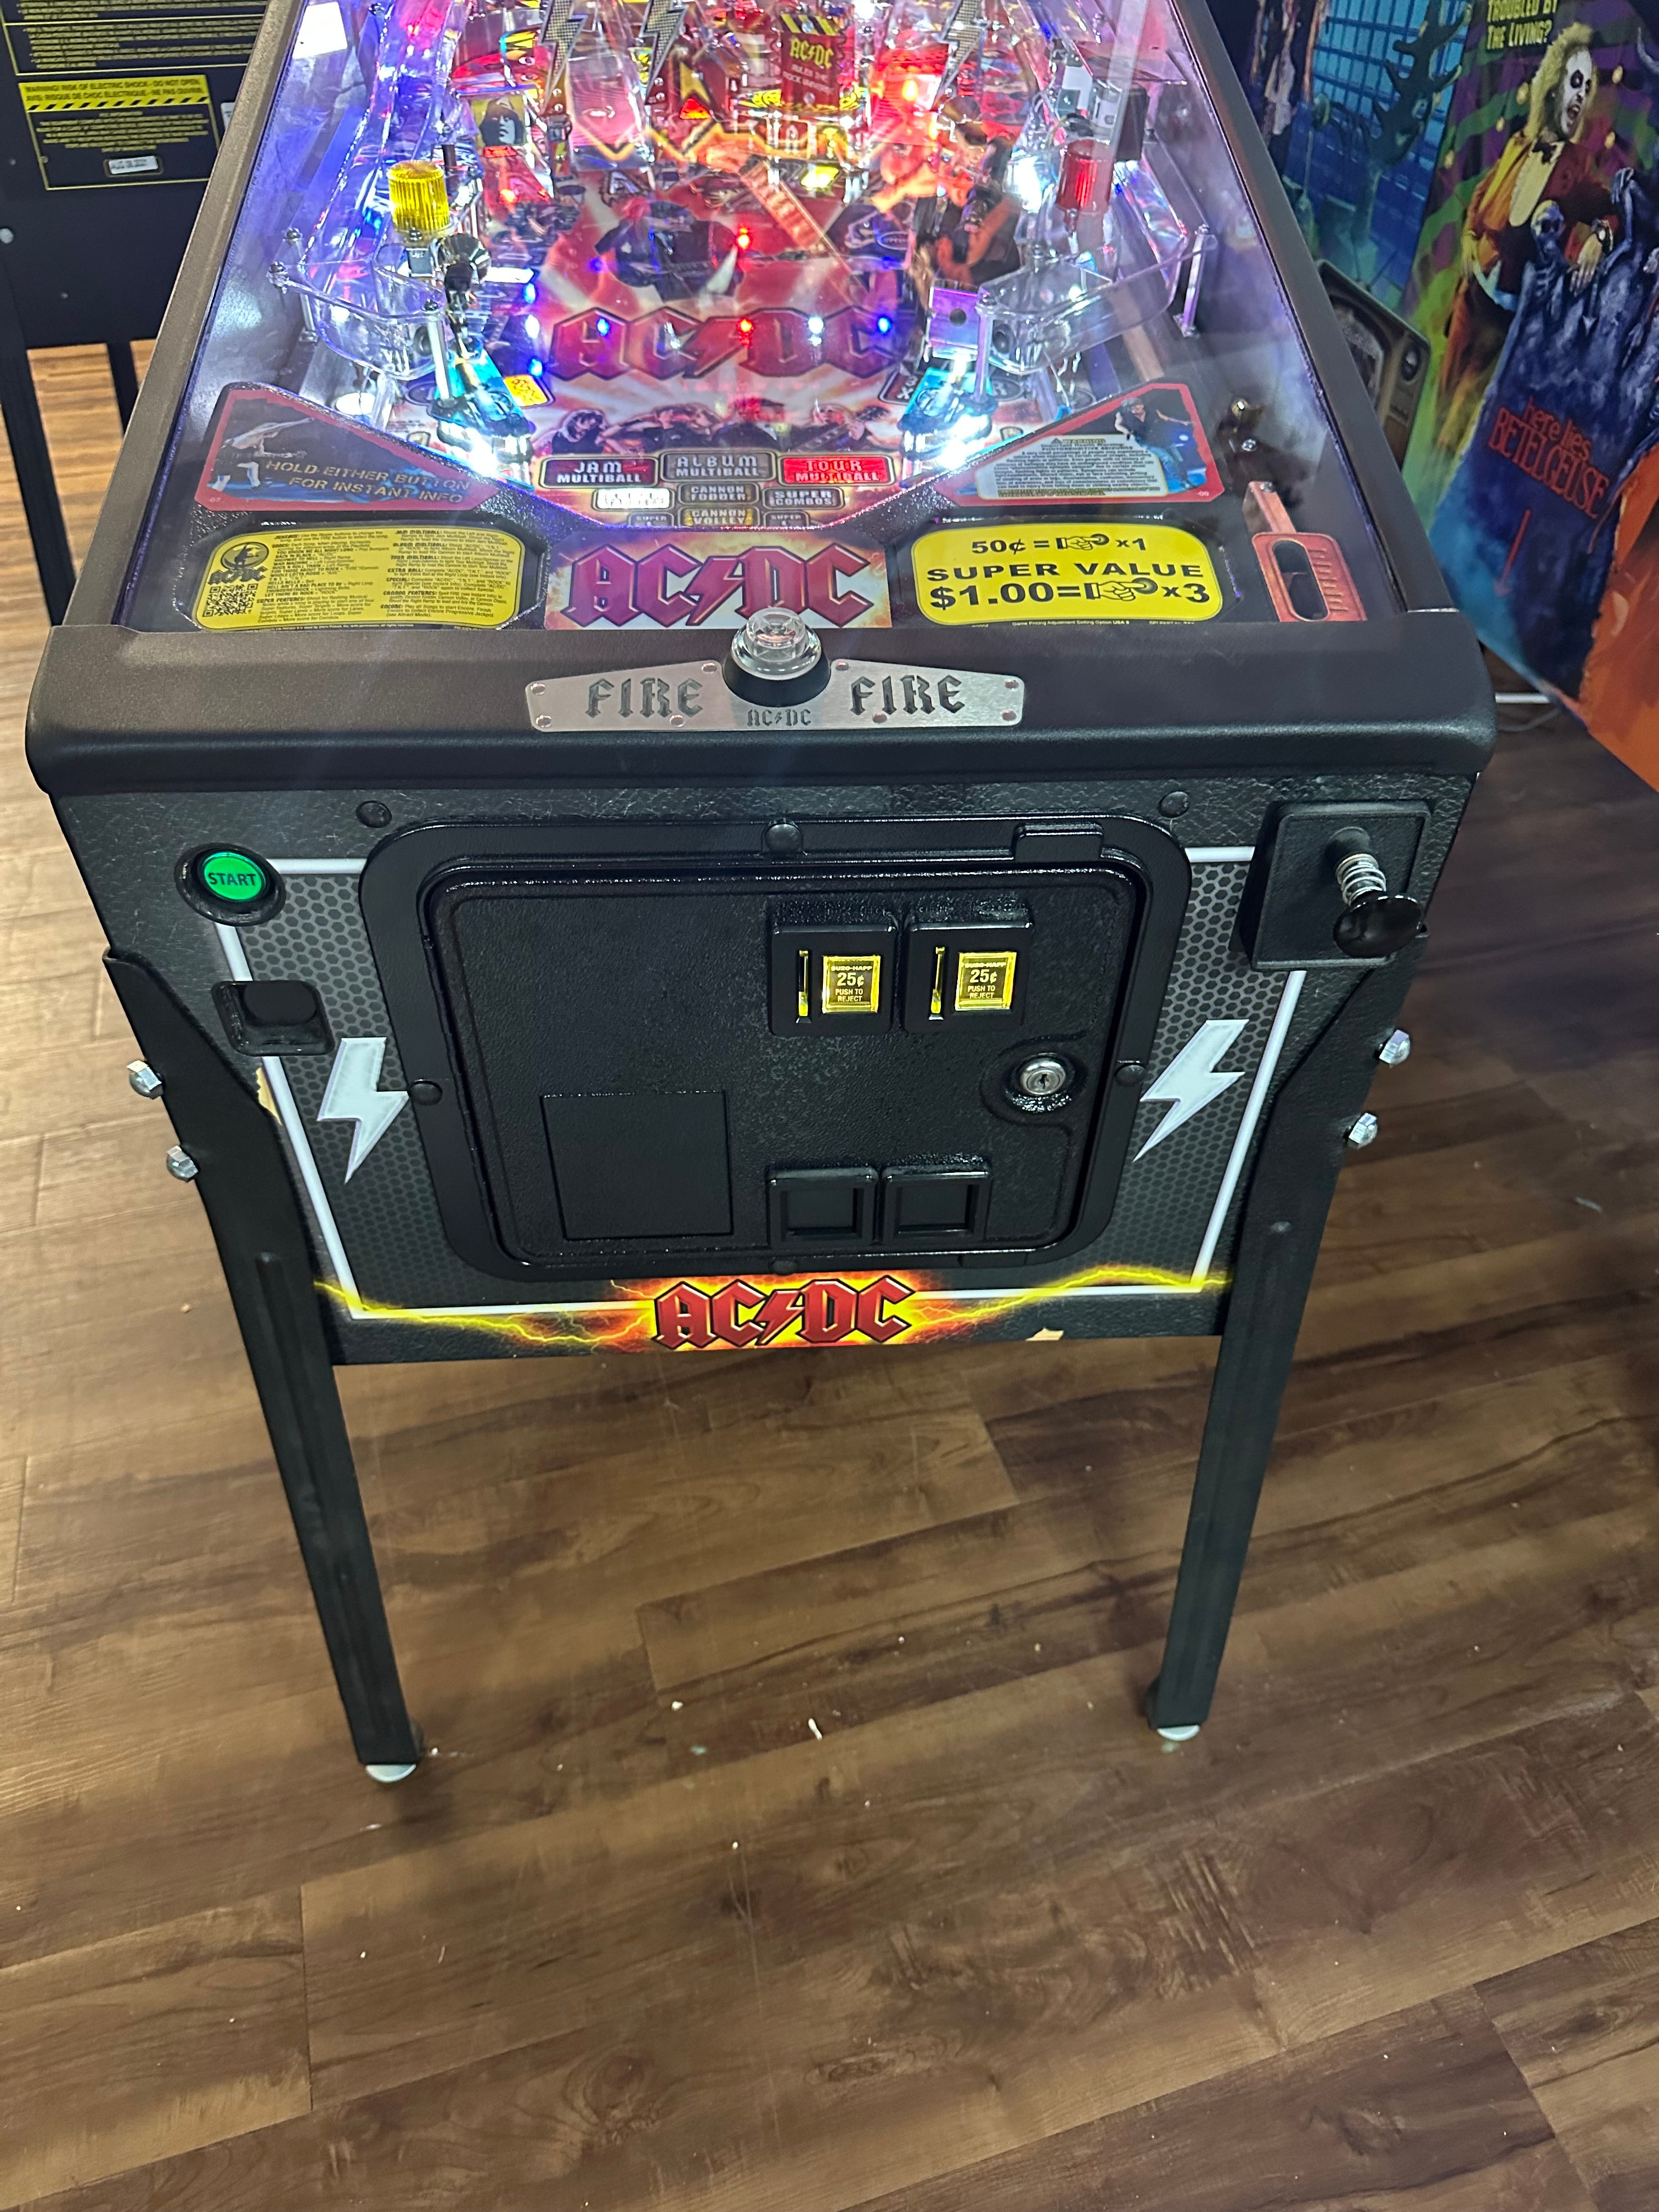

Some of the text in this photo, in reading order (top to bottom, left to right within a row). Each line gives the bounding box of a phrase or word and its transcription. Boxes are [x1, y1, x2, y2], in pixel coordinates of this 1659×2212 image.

[1487, 25, 1506, 49] THE
[789, 37, 834, 69] AC/DC
[1522, 396, 1593, 461] here lies
[574, 461, 622, 473] JAM
[676, 455, 758, 467] ALBUM
[805, 460, 863, 472] TOUR
[1488, 407, 1611, 520] BETELGEUSE
[266, 460, 472, 491] HOLD EITHER BUTTON
[556, 473, 641, 483] MULTIBALL
[676, 467, 759, 477] MULTIBALL
[795, 472, 879, 482] MULTIBALL
[288, 477, 464, 504] FOR INSTANT INFO
[691, 483, 744, 493] CANNON
[774, 490, 832, 499] SUPER
[691, 493, 746, 501] FODDER
[775, 498, 833, 506] COMBOS
[692, 508, 746, 517] CANNON
[693, 516, 747, 525] VOLLEY
[971, 539, 1026, 555] 50¢
[1116, 538, 1147, 551] x1
[927, 563, 1204, 582] SUPER VALUE
[560, 543, 874, 628] AC/DC
[1163, 583, 1210, 603] x3
[585, 674, 966, 718] FIRE FIRE
[747, 709, 812, 727] AC/DC
[208, 872, 257, 887] START
[837, 972, 864, 987] 25¢
[969, 969, 997, 984] 25¢
[651, 1274, 917, 1350] AC/DC
